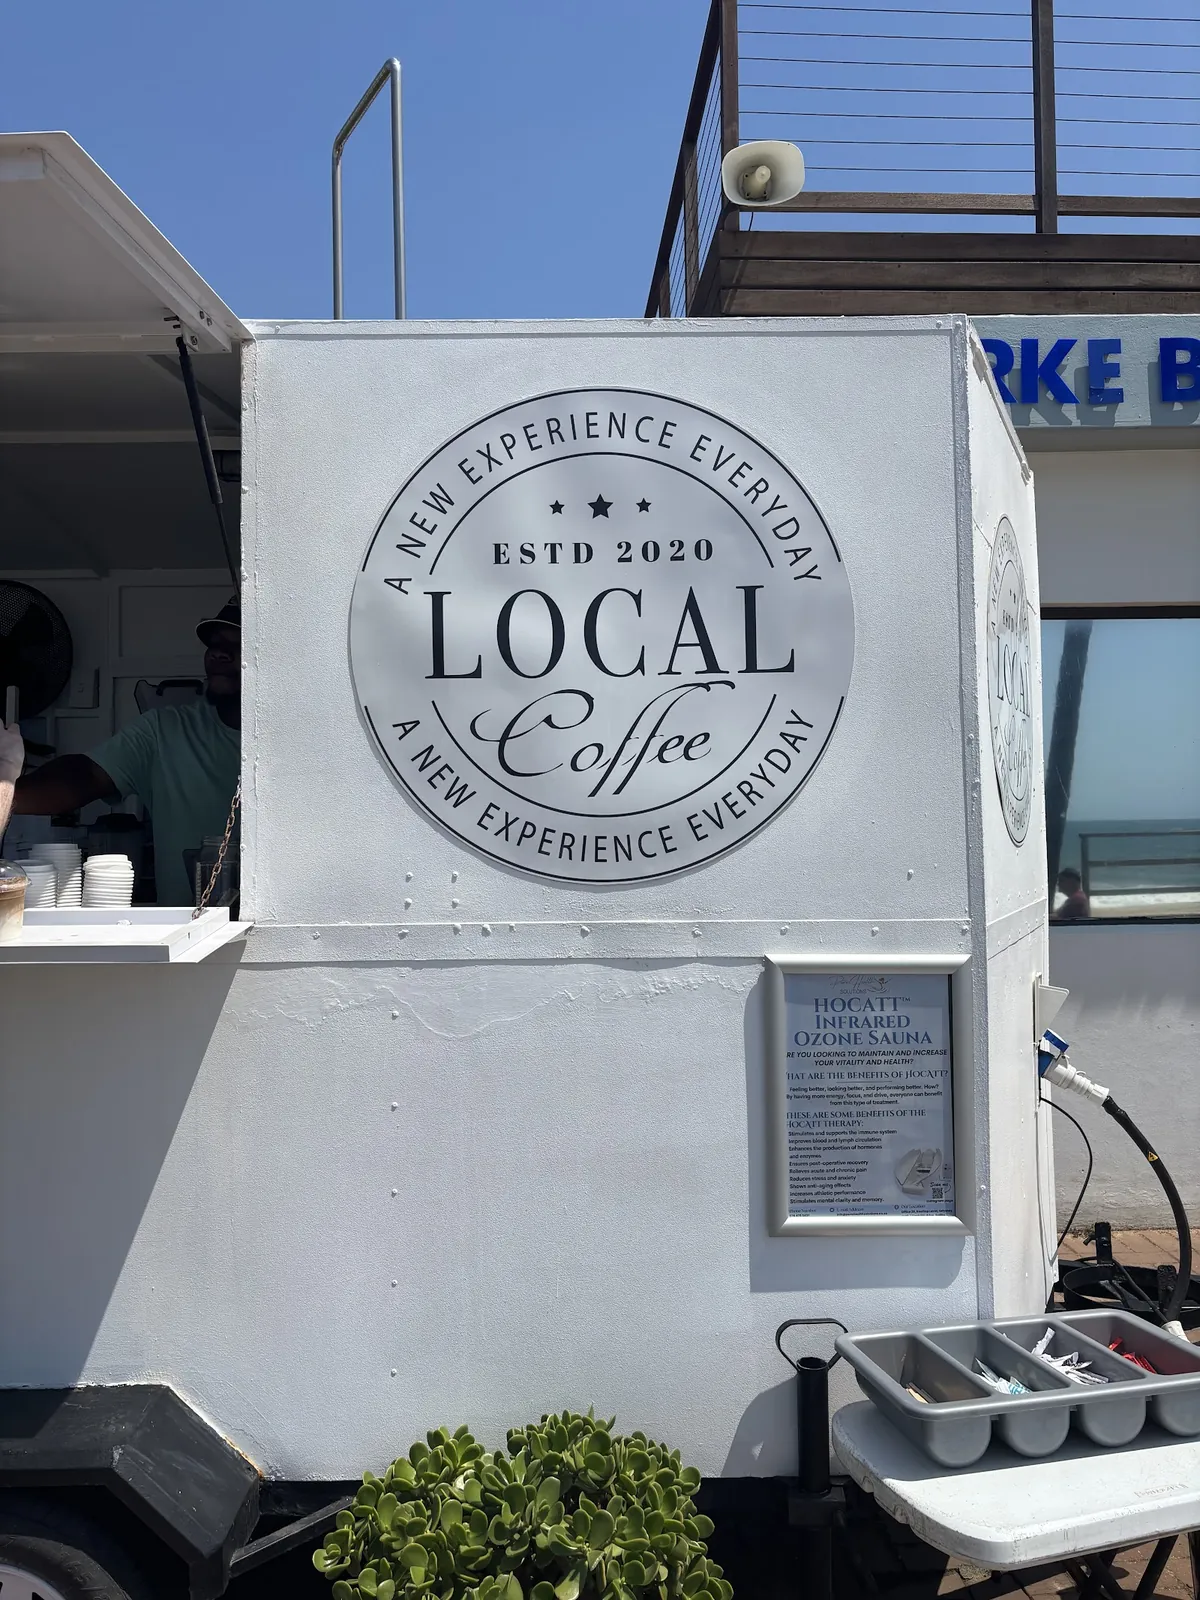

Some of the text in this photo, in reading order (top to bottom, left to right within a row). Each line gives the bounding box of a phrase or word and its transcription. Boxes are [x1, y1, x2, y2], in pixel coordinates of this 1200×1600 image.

[383, 411, 822, 595] A NEW EXPERIENCE EVERYDAY
[492, 538, 713, 565] ESTD 2020
[423, 584, 795, 679] LOCAL
[997, 634, 1031, 719] LOCAL
[469, 680, 736, 797] Coffee
[392, 709, 815, 863] A NEW EXPERIENCE EVERYDAY
[786, 1071, 806, 1080] HAT
[807, 1072, 826, 1080] ARE
[826, 1072, 845, 1080] THE
[847, 1071, 890, 1079] BENEFITS
[786, 1111, 811, 1120] THESE
[896, 1109, 908, 1117] OF
[908, 1108, 926, 1116] THE
[823, 1120, 864, 1128] THERAPY:
